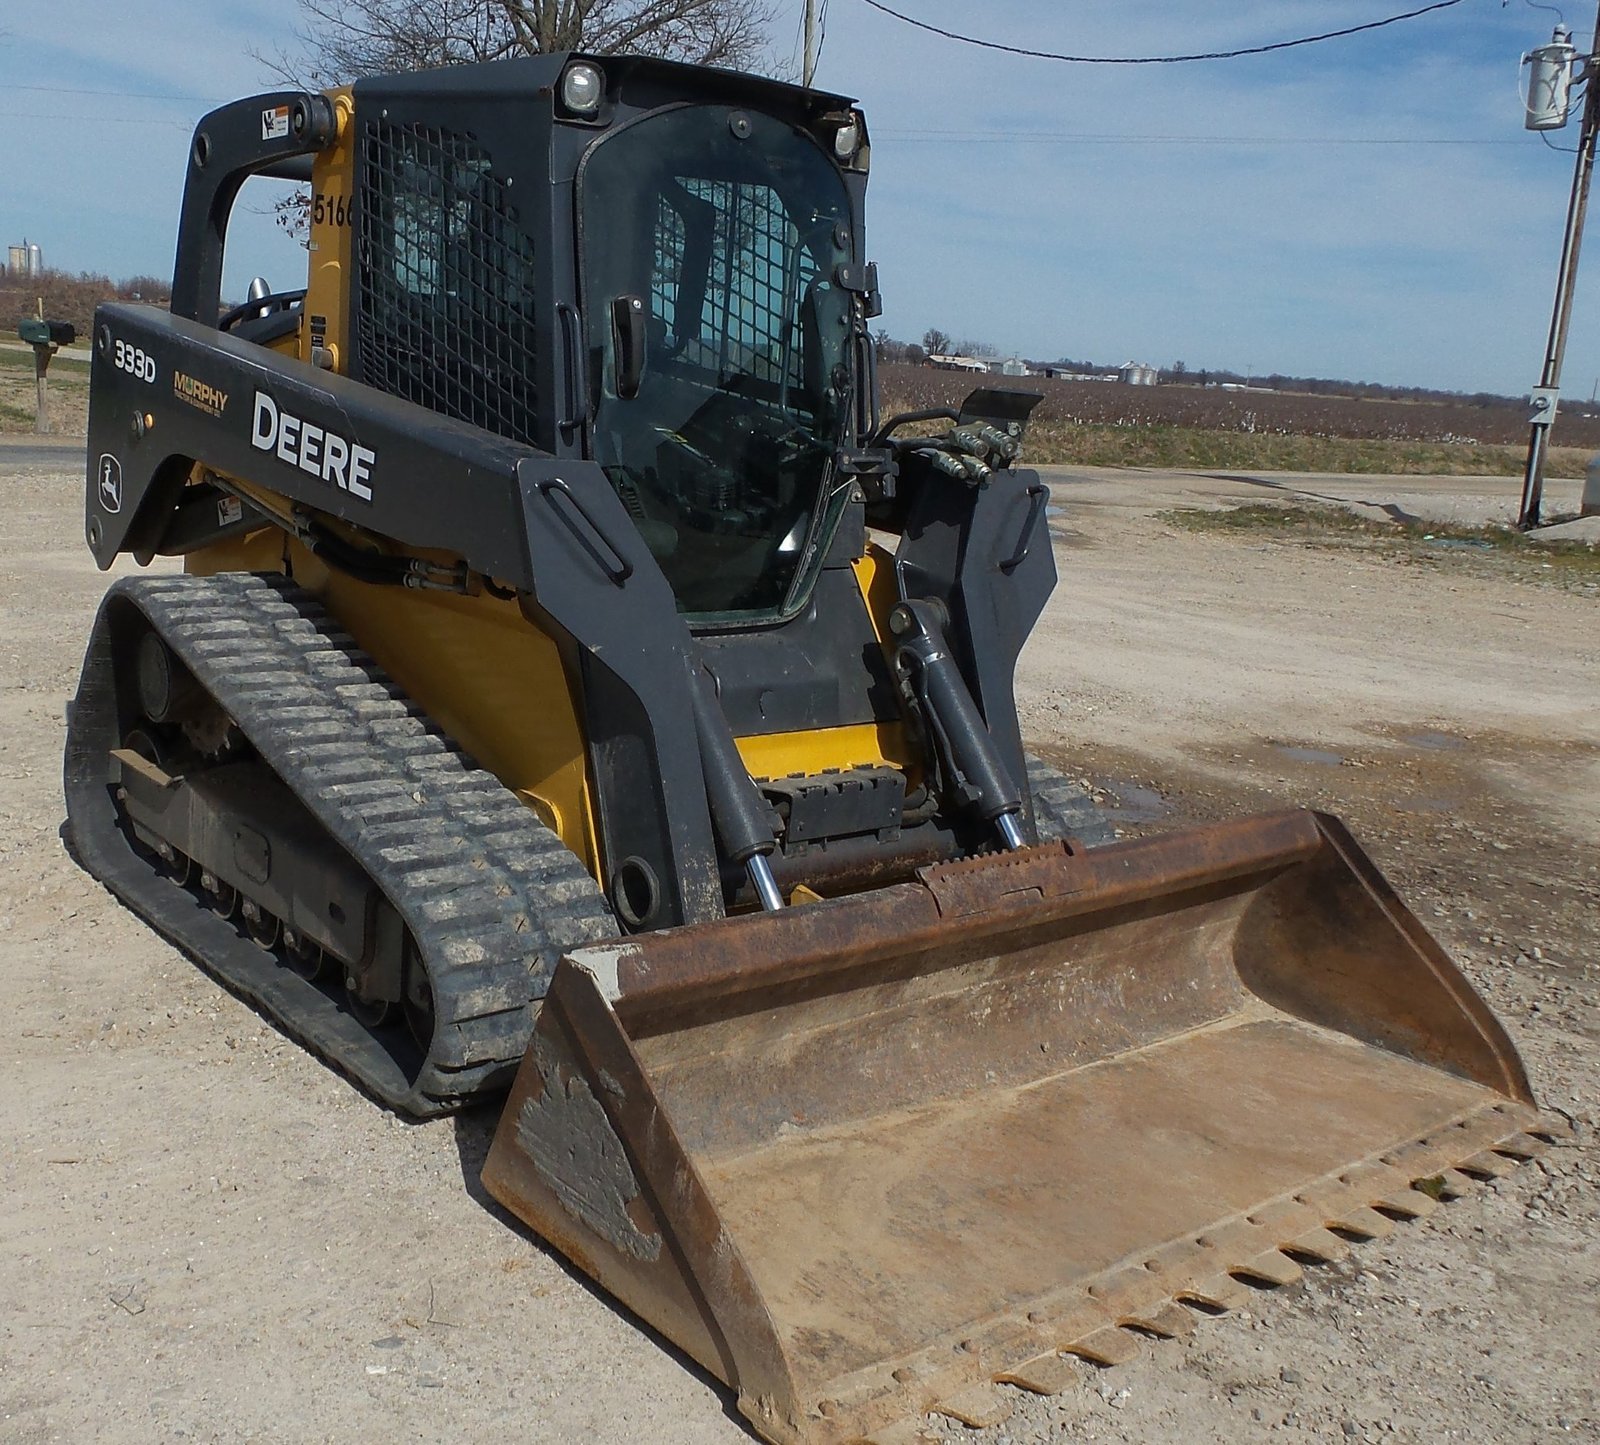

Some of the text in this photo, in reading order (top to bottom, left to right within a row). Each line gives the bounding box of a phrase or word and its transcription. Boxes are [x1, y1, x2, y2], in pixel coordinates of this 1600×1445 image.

[114, 339, 156, 383] 333D
[174, 370, 228, 411] MURPHY
[251, 390, 376, 501] DEERE
